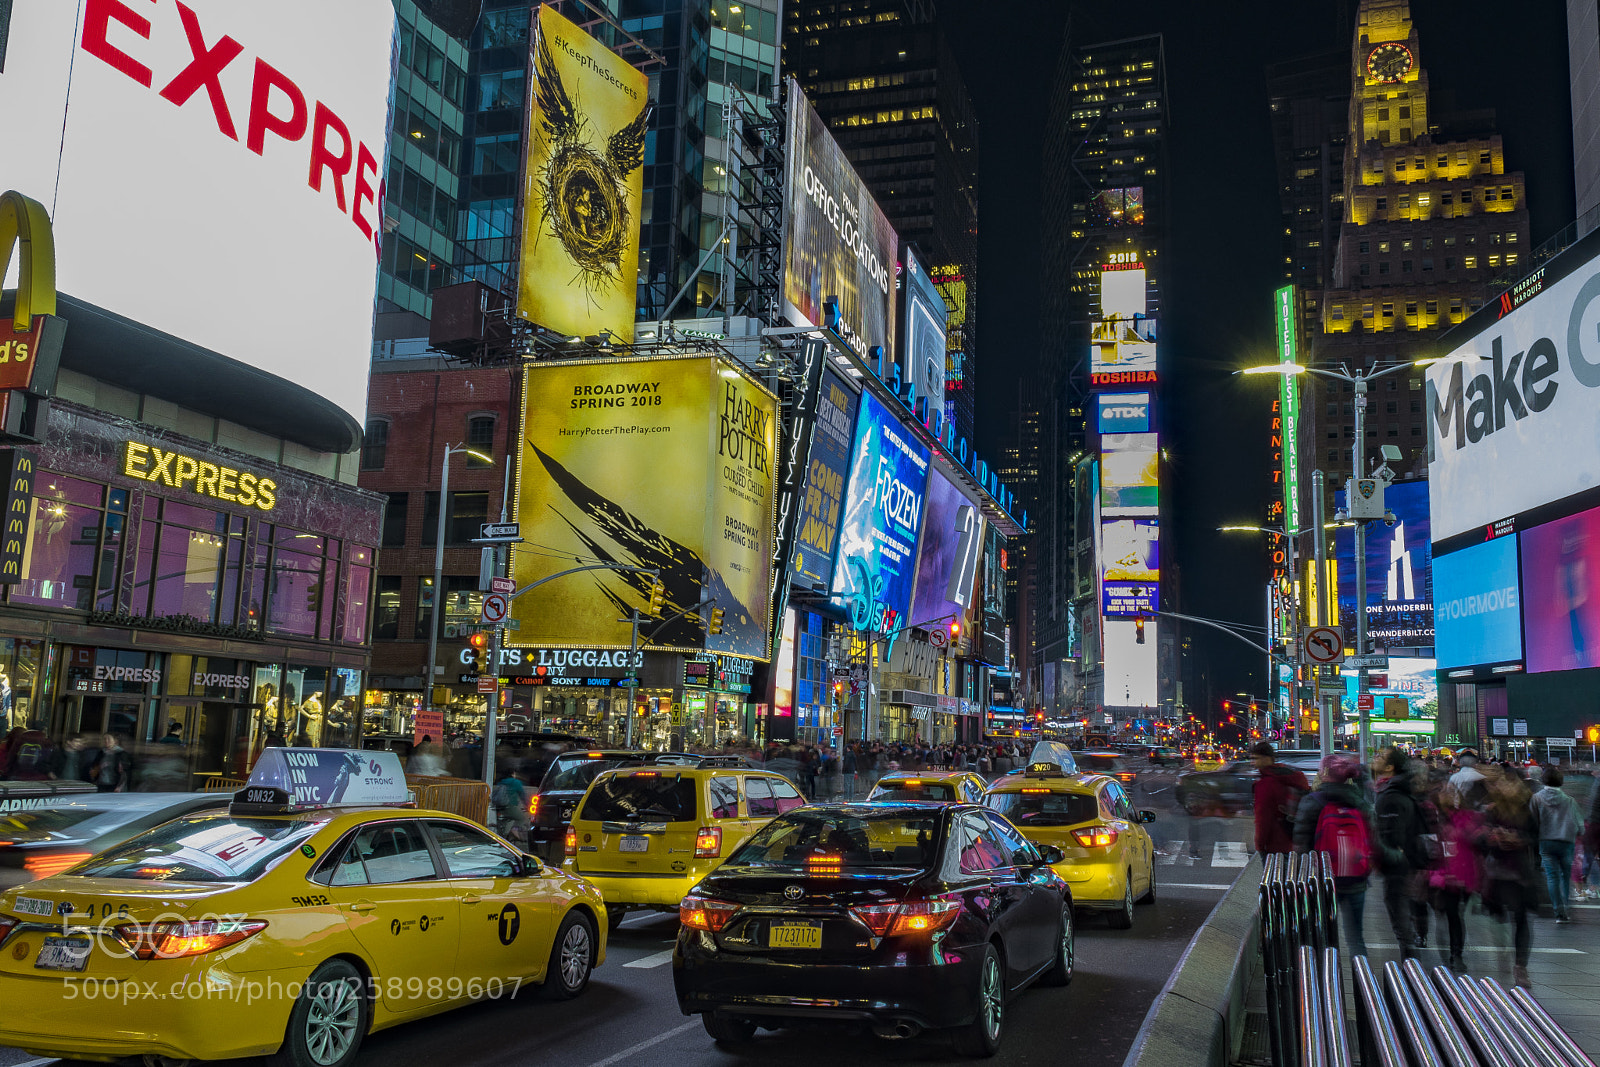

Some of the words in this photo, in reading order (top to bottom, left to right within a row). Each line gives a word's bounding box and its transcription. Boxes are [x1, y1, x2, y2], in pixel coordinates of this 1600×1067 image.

[554, 35, 637, 100] #KeepTheSecrets
[843, 192, 858, 224] PRIME
[804, 165, 838, 230] OFFICE
[841, 212, 888, 294] LOCATIONS
[1102, 262, 1145, 271] TOSHIBA
[1109, 253, 1137, 264] 2018
[1514, 268, 1545, 295] MARRIOTT
[1514, 281, 1542, 305] MARQUIS
[684, 329, 722, 340] LAMAR
[1091, 370, 1158, 384] TOSHIBA
[573, 382, 661, 396] BROADWAY
[1282, 291, 1290, 356] VOTED
[1288, 416, 1296, 482] BEACH
[570, 397, 625, 409] SPRING
[631, 395, 662, 407] 2018
[1426, 335, 1559, 465] Make
[724, 380, 770, 444] HARRY
[1112, 406, 1146, 418] TDK
[559, 425, 671, 437] HarryPotterThePlay.com
[718, 414, 770, 479] POTTER
[125, 442, 277, 510] EXPRESS
[723, 466, 747, 489] CURSED
[747, 479, 765, 497] CHILD
[810, 459, 843, 501] COME
[872, 454, 923, 533] FROZEN
[504, 526, 515, 534] WAY
[725, 515, 759, 539] BROADWAY
[1495, 517, 1515, 528] MARRIOTT
[723, 529, 746, 547] SPRING
[747, 540, 759, 552] 2018
[799, 515, 836, 554] AWAY
[1365, 605, 1383, 613] ONE
[1437, 586, 1516, 622] #YOURMOVE
[460, 649, 521, 667] GFTS
[538, 649, 644, 668] LUGGAGE
[94, 665, 161, 683] EXPRESS
[193, 672, 250, 689] EXPRESS
[515, 677, 545, 685] Canon
[552, 677, 581, 685] SONY
[587, 678, 611, 686] BOWER
[286, 753, 319, 767] NOW
[1034, 763, 1051, 772] 3V20
[292, 769, 307, 784] IN
[364, 777, 393, 785] STRONG
[247, 789, 275, 803] 9M32
[295, 787, 321, 802] NYC
[86, 903, 129, 920] 406
[488, 913, 498, 921] NYC
[774, 927, 817, 943] T723717C
